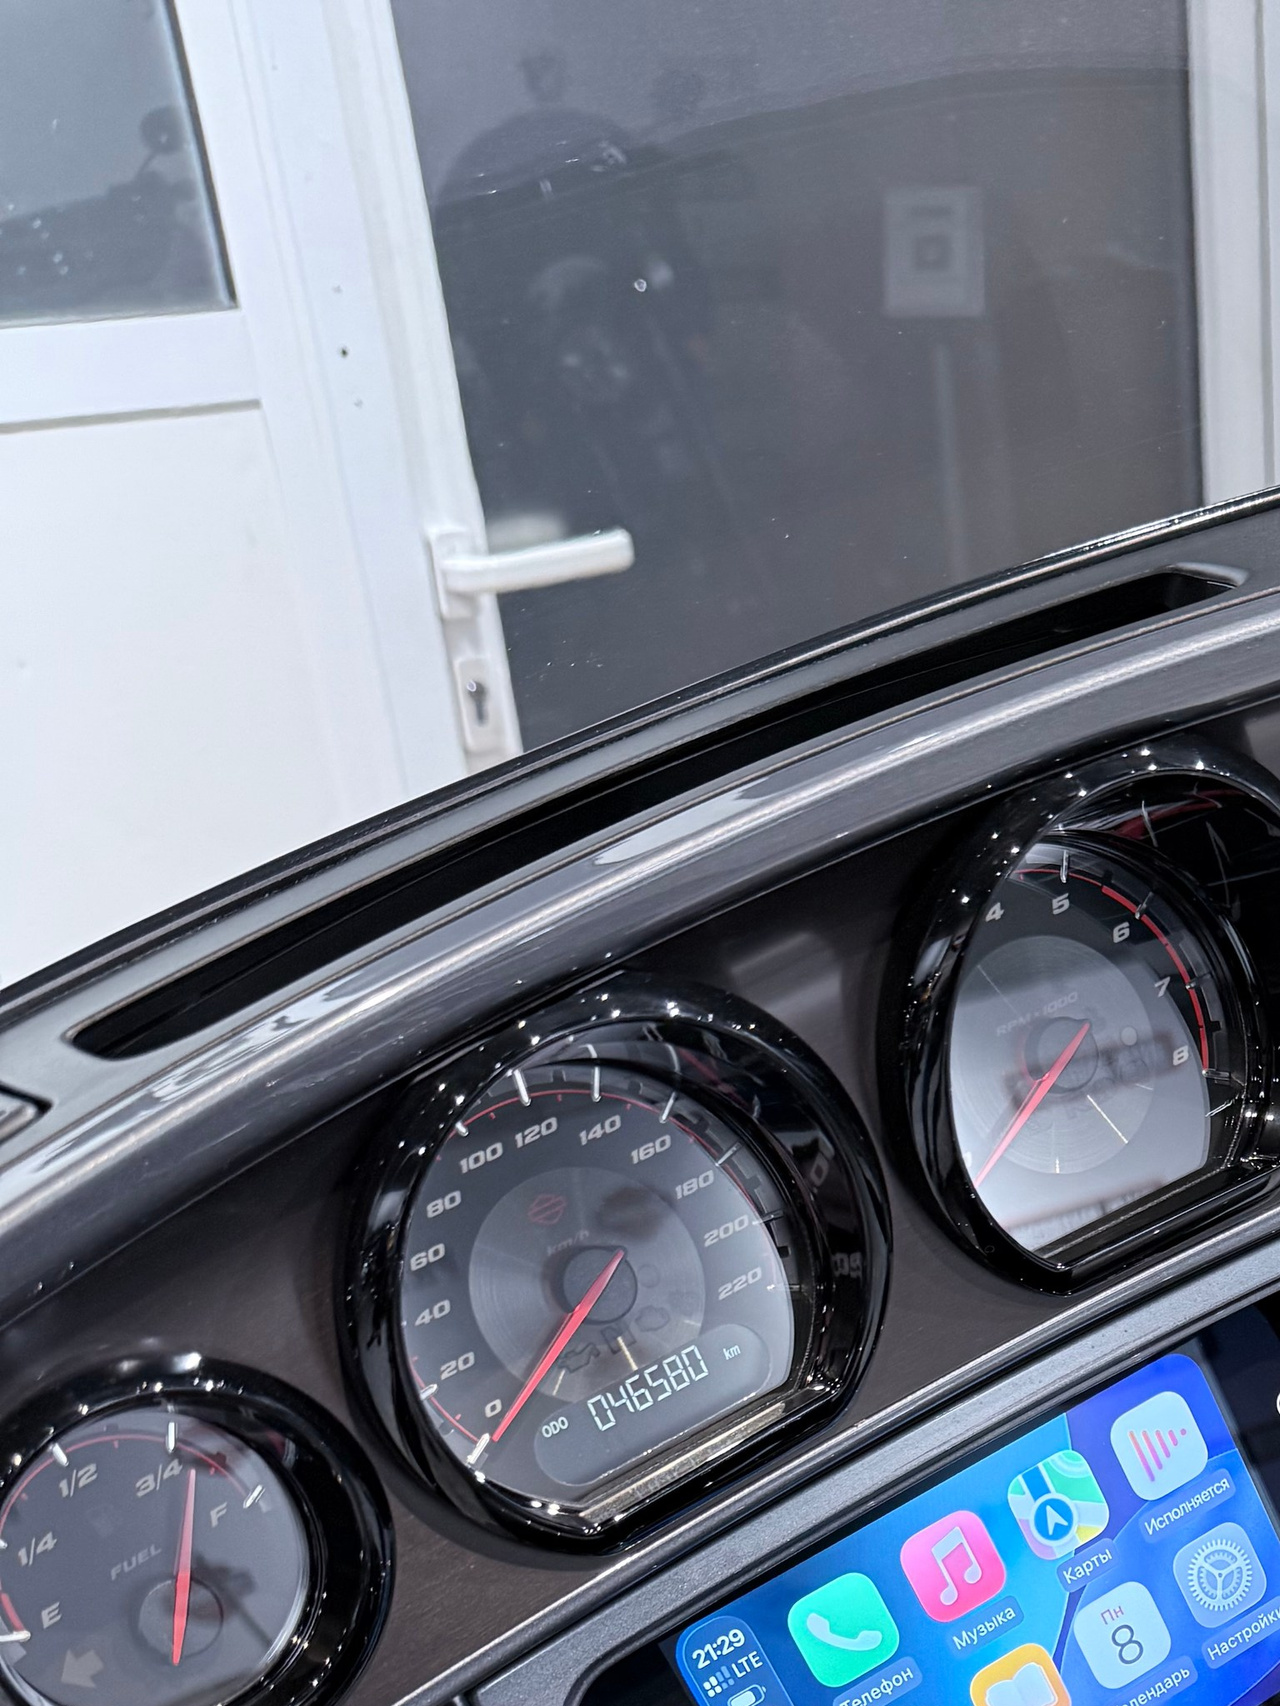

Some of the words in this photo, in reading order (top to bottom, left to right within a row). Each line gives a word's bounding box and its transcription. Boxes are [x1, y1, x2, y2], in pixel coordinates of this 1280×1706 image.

[985, 902, 1005, 922] 4
[1052, 893, 1070, 915] 5
[1112, 922, 1130, 943] 6
[1154, 976, 1171, 998] 7
[1172, 1045, 1189, 1066] 8
[514, 1117, 558, 1150] 120
[579, 1114, 622, 1147] 140
[459, 1142, 503, 1174] 100
[631, 1134, 672, 1164] 160
[675, 1170, 715, 1200] 180
[426, 1190, 462, 1219] 80
[704, 1215, 750, 1247] 200
[410, 1243, 445, 1272] 60
[718, 1267, 763, 1301] 220
[415, 1301, 451, 1328] 40
[440, 1352, 476, 1380] 20
[541, 1415, 569, 1439] ODO
[586, 1345, 709, 1432] 046580
[723, 1342, 742, 1361] km
[484, 1398, 502, 1419] 0
[58, 1463, 99, 1498] 1/2
[135, 1458, 183, 1499] 3/4
[209, 1502, 229, 1528] F
[1144, 1478, 1230, 1535] Исполняется
[17, 1531, 58, 1567] 1/4
[110, 1544, 162, 1581] FUEL
[1062, 1548, 1113, 1584] Карты
[41, 1601, 63, 1629] E
[952, 1607, 1016, 1650] Музыка
[1101, 1605, 1125, 1625] Пн
[691, 1628, 746, 1669] 21:29
[1111, 1624, 1144, 1665] 8
[731, 1651, 764, 1678] LTE
